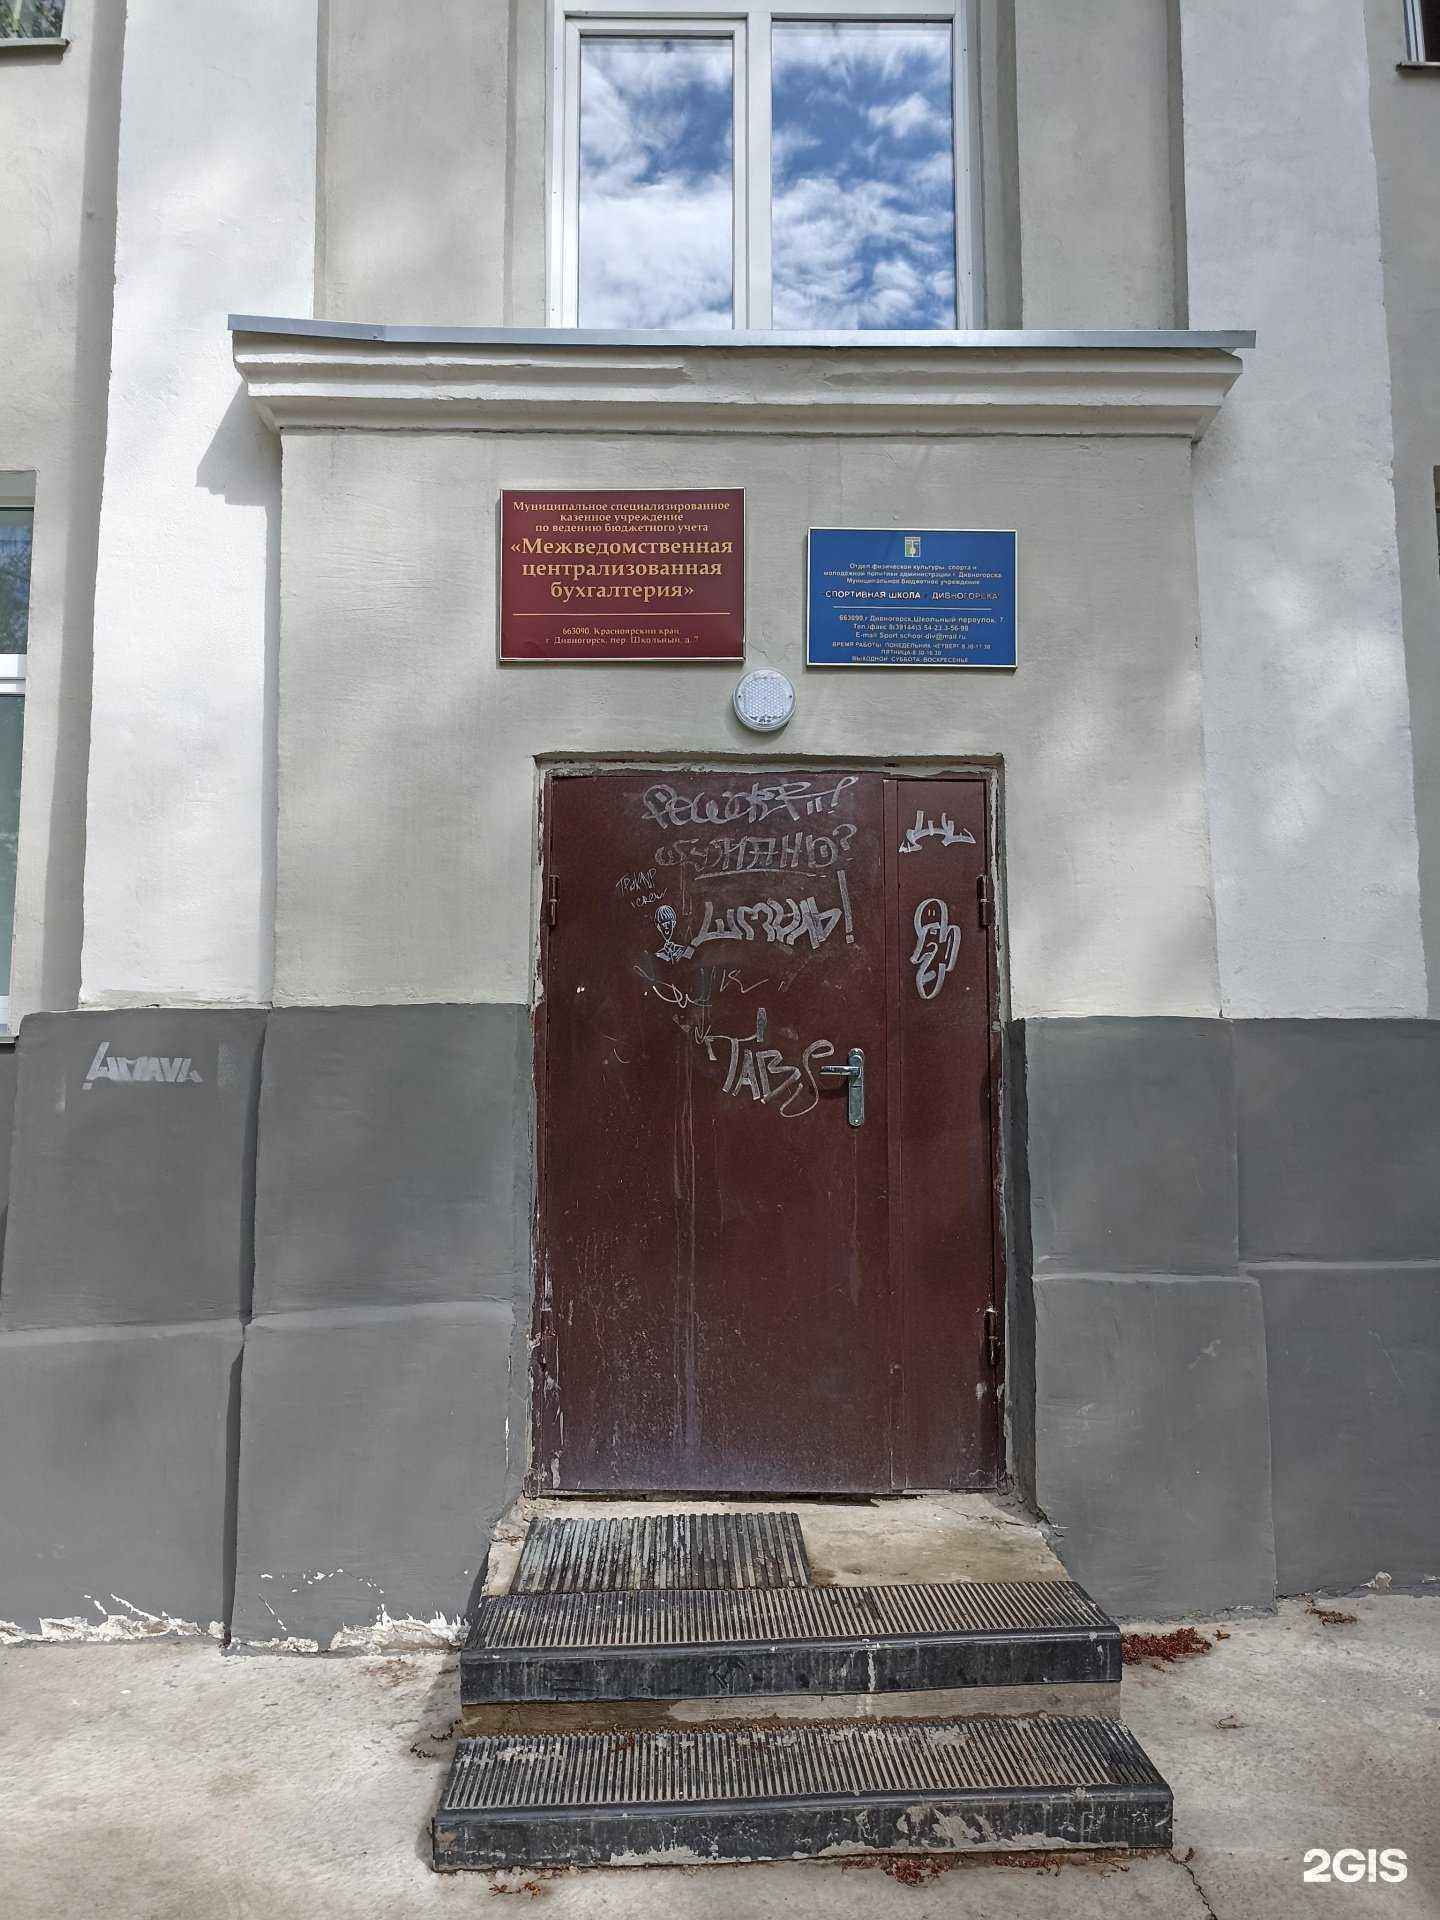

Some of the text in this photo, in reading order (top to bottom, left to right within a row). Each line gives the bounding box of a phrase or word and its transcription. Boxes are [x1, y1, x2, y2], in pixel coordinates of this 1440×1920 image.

[513, 501, 730, 513] Муниципальное специализированное
[560, 513, 684, 524] казенное учреждение
[535, 522, 708, 533] по ведению бюджетного учета
[510, 537, 733, 555] «Межведомственная
[522, 563, 722, 580] централизованная
[550, 581, 694, 603] бухгалтерия»
[888, 591, 920, 600] ШКОЛА
[594, 627, 656, 636] Красноярский
